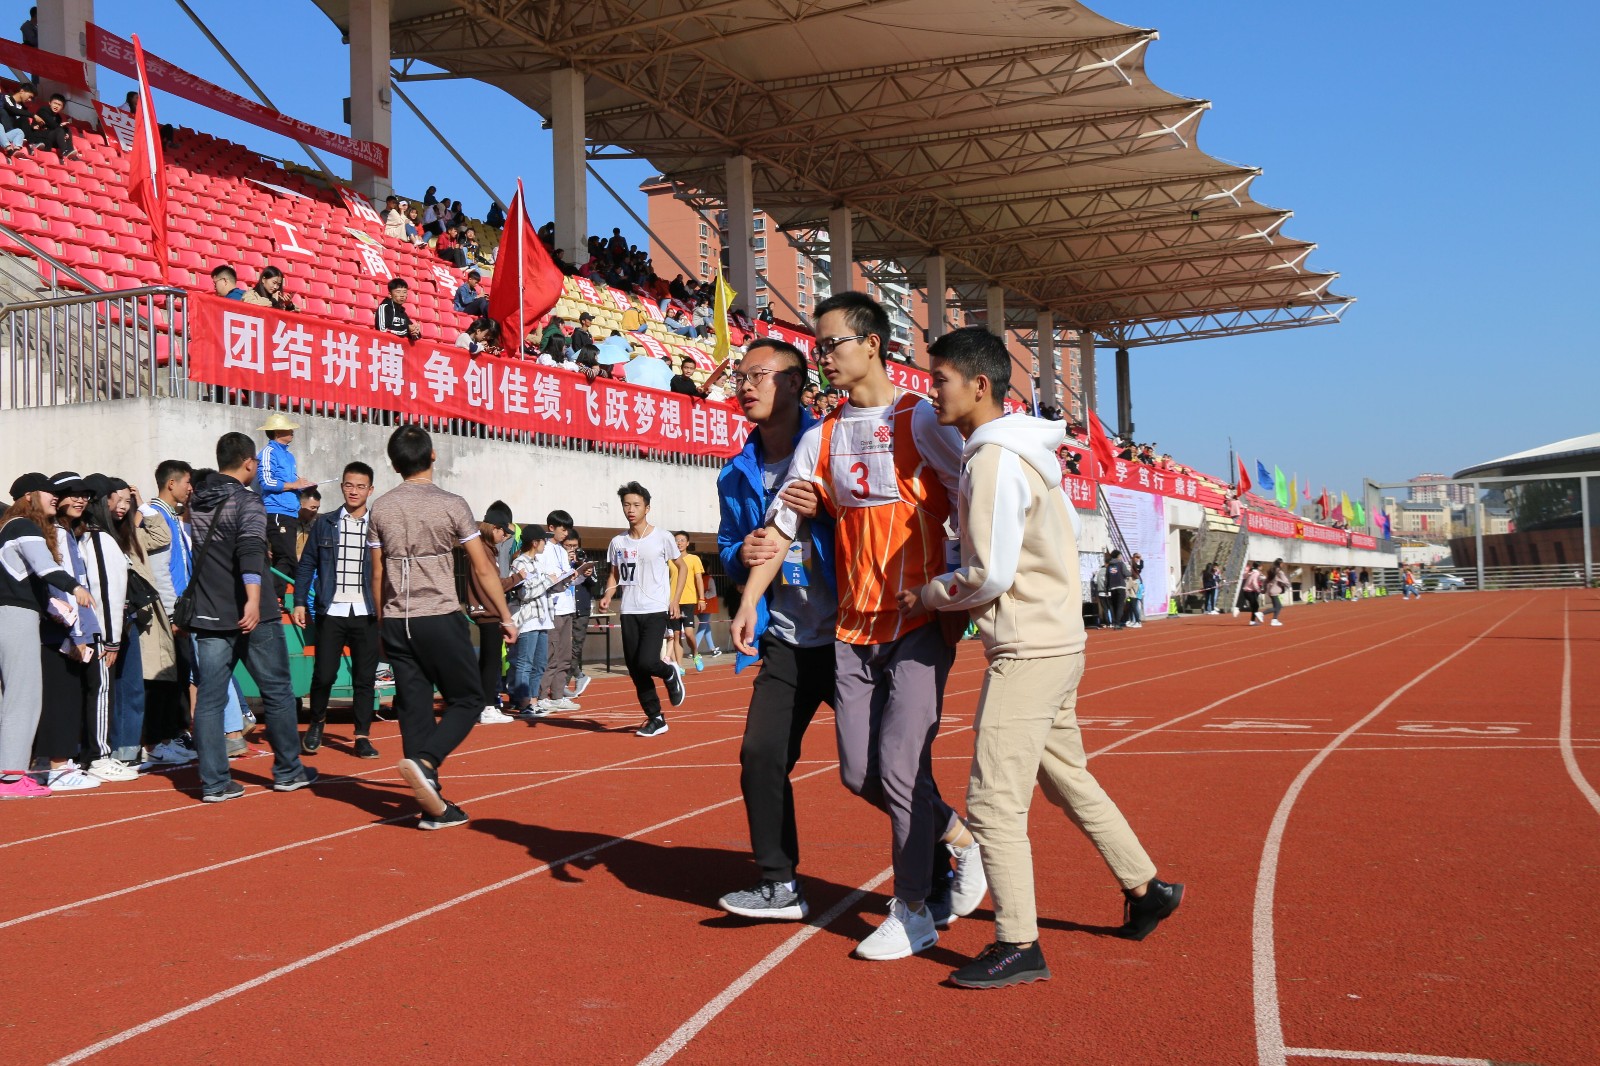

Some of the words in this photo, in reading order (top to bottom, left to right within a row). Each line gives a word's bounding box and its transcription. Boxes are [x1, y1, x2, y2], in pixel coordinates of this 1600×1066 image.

[341, 186, 385, 227] 油
[273, 218, 313, 256] 工
[356, 242, 392, 280] 商
[578, 279, 600, 304] 学
[850, 461, 870, 500] 3
[620, 562, 637, 582] 07
